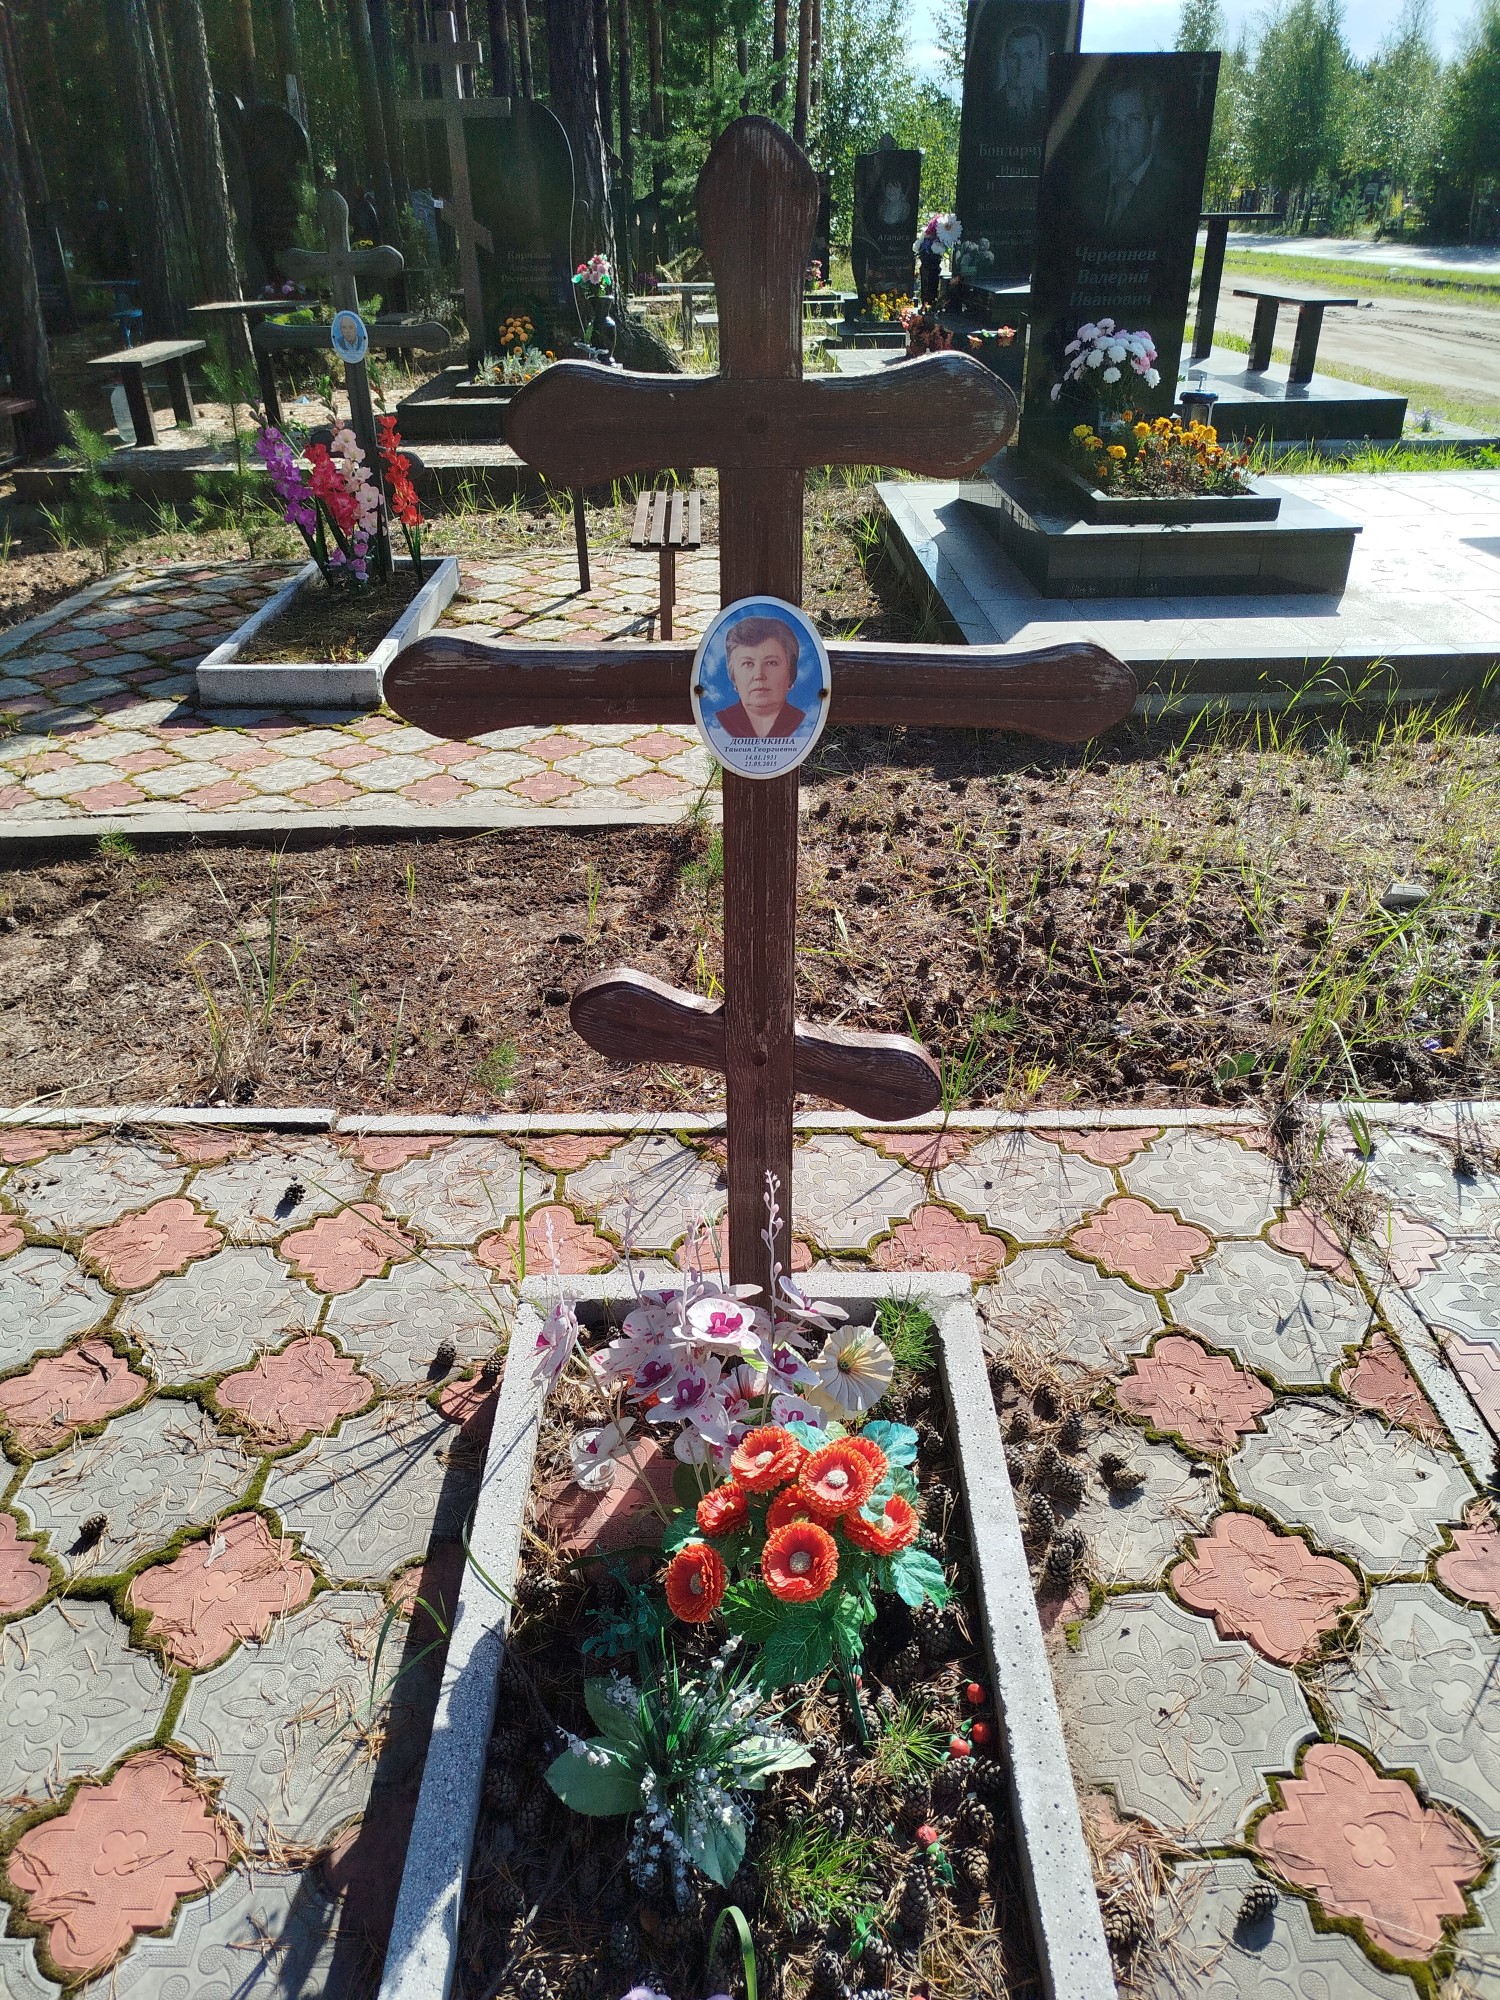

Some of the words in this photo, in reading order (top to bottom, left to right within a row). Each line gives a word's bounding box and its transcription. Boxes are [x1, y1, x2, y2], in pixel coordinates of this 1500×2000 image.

[979, 144, 1041, 159] Бондарчу
[1000, 164, 1028, 175] Иван
[1075, 247, 1157, 265] Черепнев
[1076, 269, 1149, 287] Валерий
[1069, 291, 1152, 307] Иванович
[730, 738, 795, 746] ДОЩЕЧКИНА
[753, 746, 797, 754] Георгиевна
